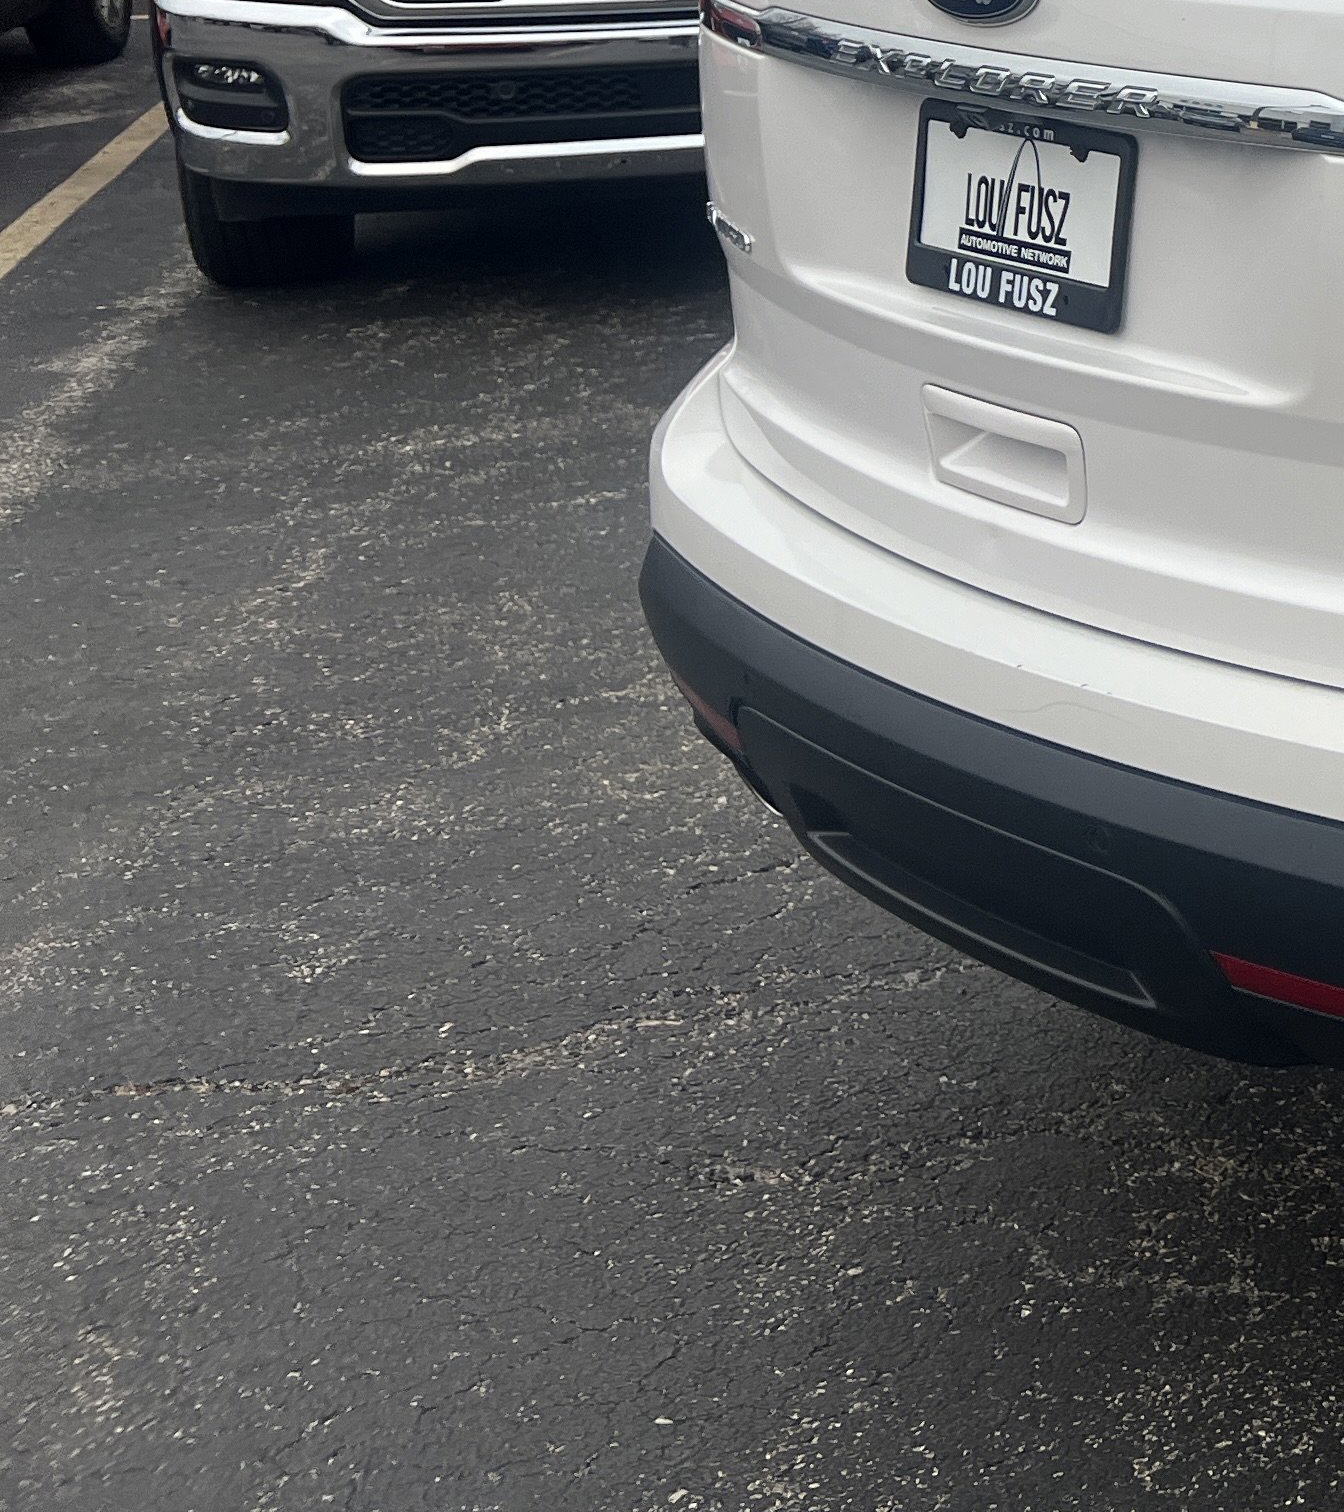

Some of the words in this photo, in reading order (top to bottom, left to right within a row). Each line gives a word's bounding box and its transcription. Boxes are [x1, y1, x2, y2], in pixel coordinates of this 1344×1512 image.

[830, 38, 1160, 119] EXPLORER
[964, 172, 1005, 234] LOU
[1013, 182, 1071, 247] FUSZ
[959, 232, 1019, 258] AUTOMOTIVE
[1021, 247, 1069, 269] NETWORK
[948, 258, 993, 299] LOU
[998, 271, 1060, 316] FUSZ
